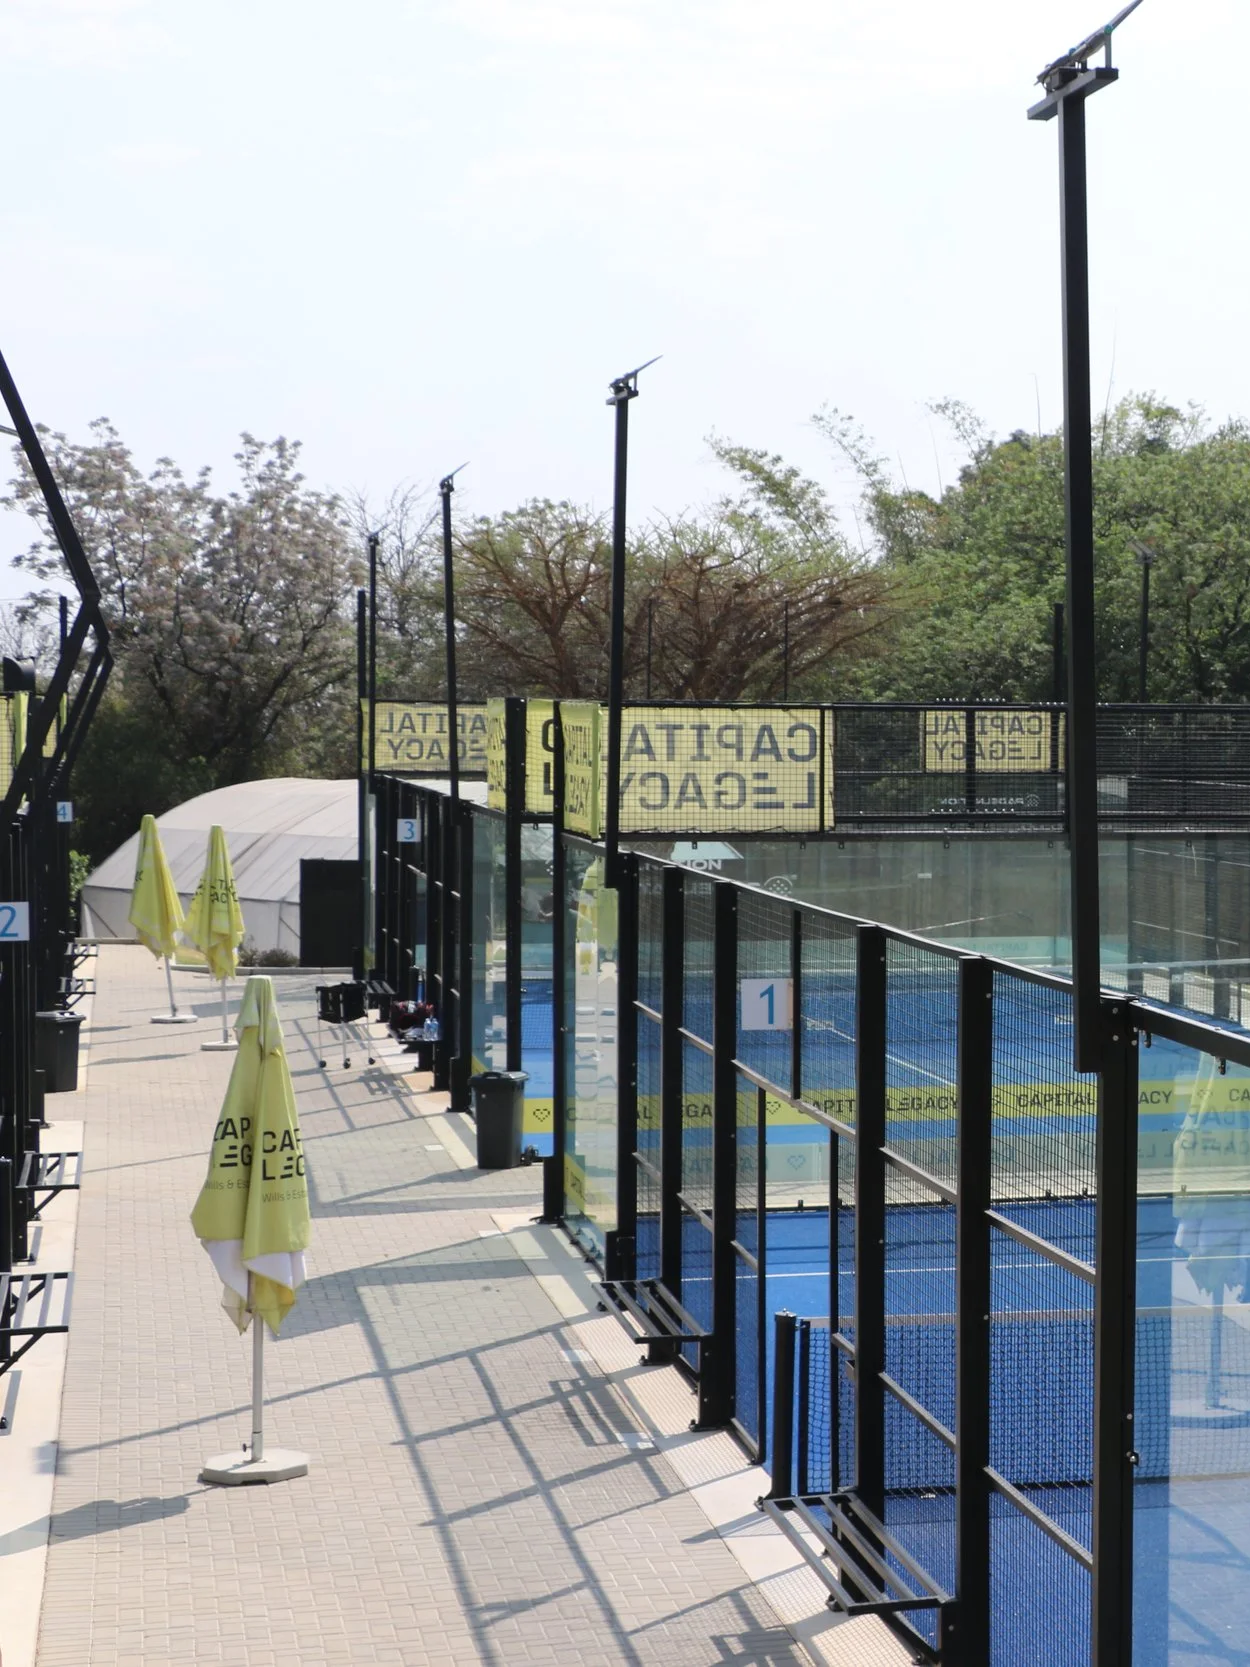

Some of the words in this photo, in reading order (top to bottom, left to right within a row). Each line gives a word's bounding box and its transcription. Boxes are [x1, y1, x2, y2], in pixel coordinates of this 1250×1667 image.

[56, 804, 67, 820] 4
[403, 822, 415, 840] 3
[0, 905, 18, 938] 2
[759, 984, 775, 1025] 1
[1016, 1091, 1095, 1108] CAPITAL
